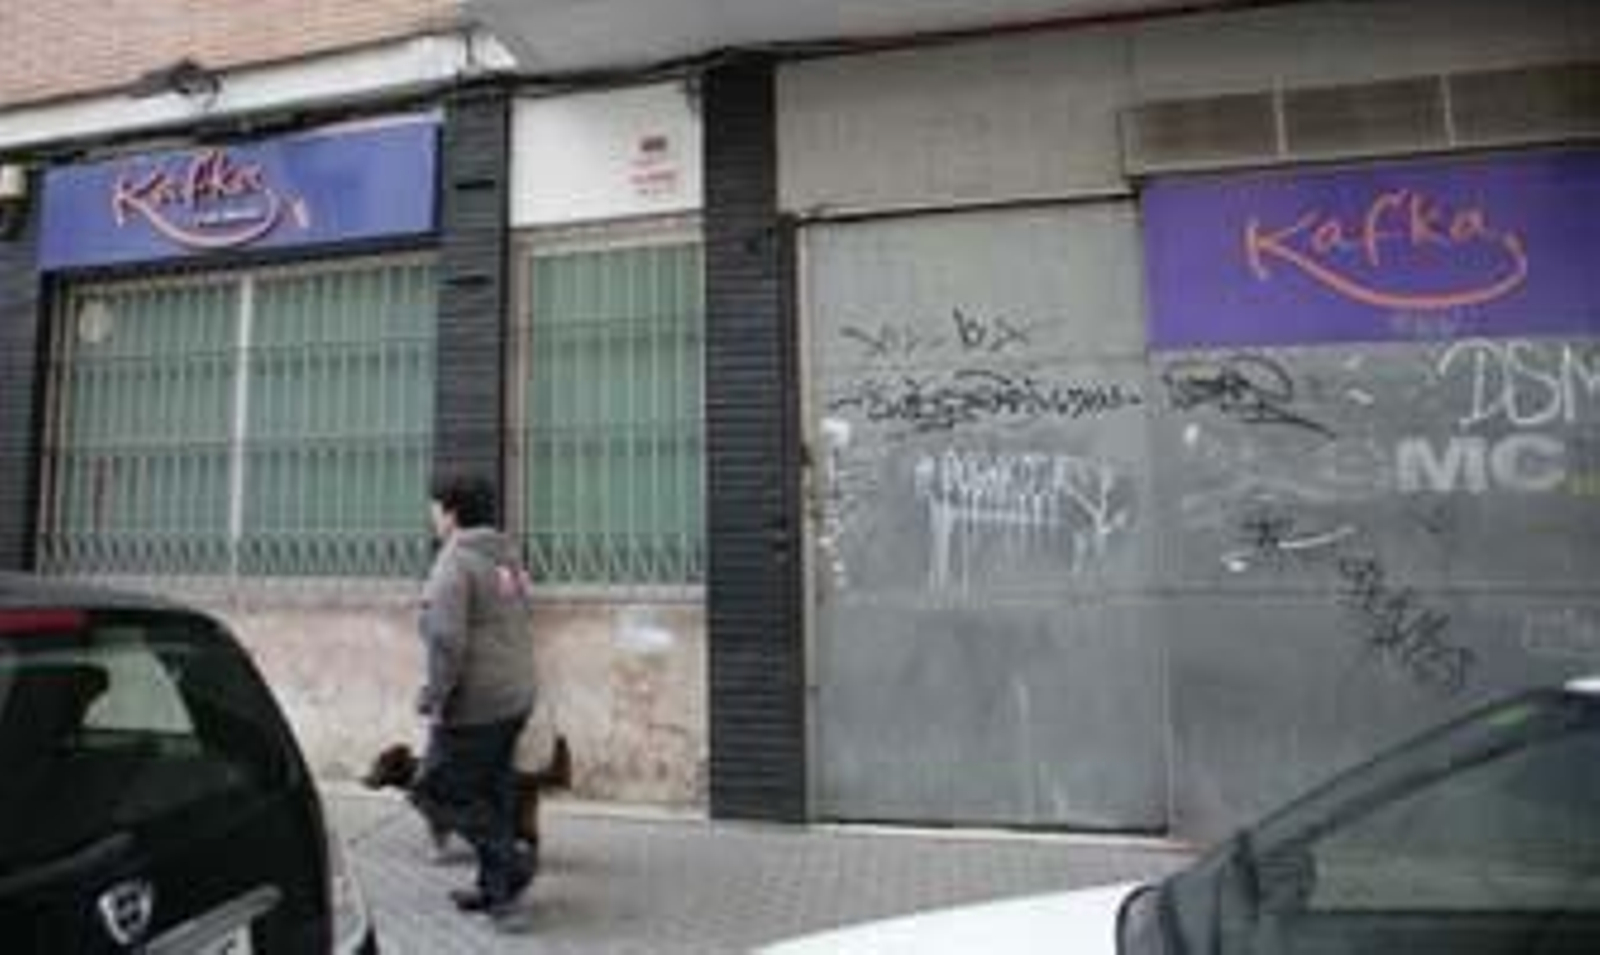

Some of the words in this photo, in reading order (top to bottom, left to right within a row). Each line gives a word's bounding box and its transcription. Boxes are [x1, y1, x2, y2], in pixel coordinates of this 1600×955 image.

[112, 149, 285, 246] Kafka
[1244, 188, 1528, 309] Kafka
[1396, 434, 1566, 492] MC
